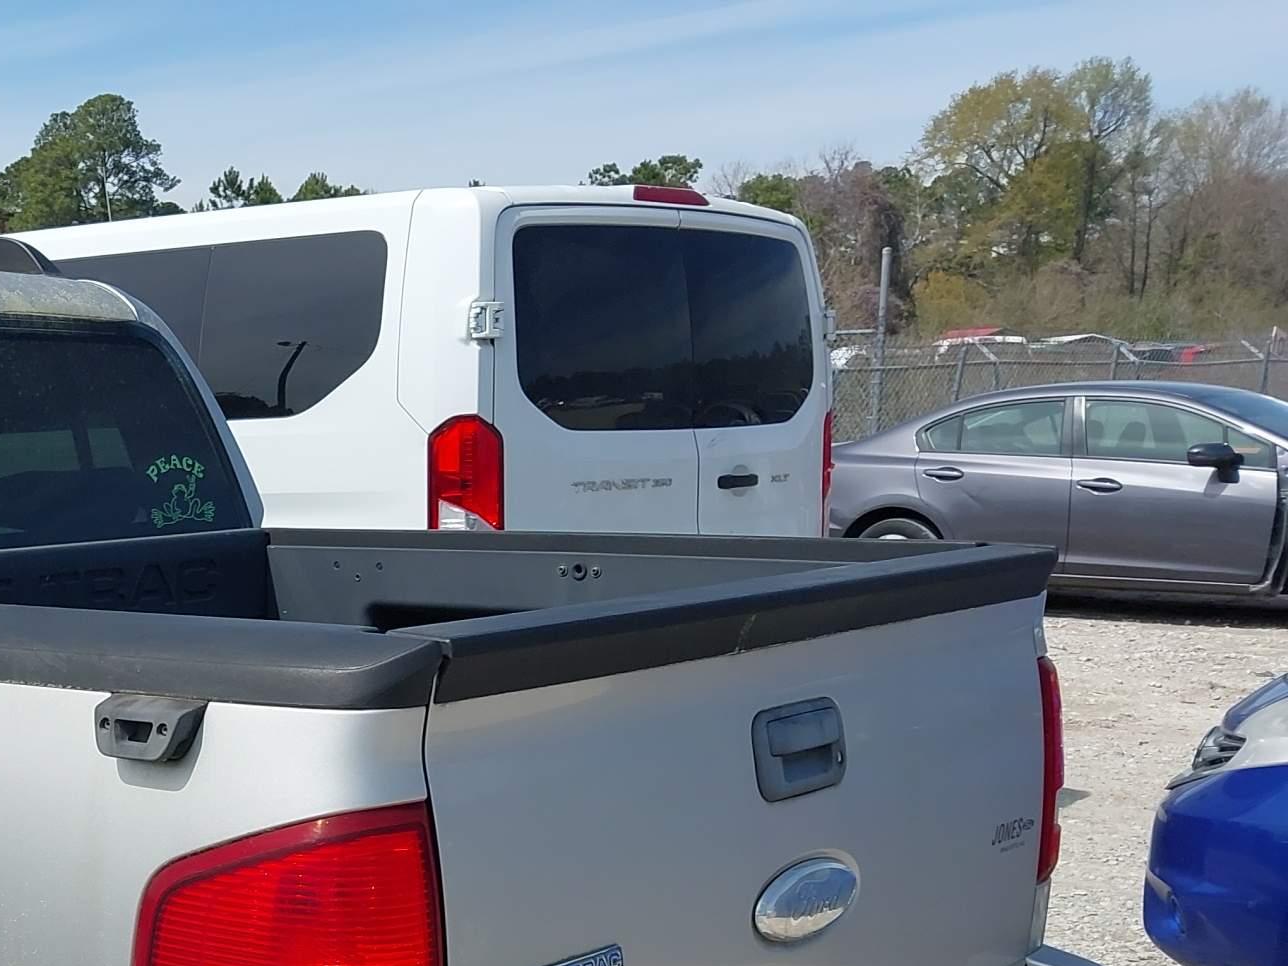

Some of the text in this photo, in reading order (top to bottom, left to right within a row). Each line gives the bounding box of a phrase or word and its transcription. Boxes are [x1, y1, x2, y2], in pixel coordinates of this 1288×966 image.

[146, 454, 205, 483] PEACE
[770, 473, 790, 483] XLT
[570, 477, 651, 494] TRANSIT
[992, 818, 1023, 846] JONES
